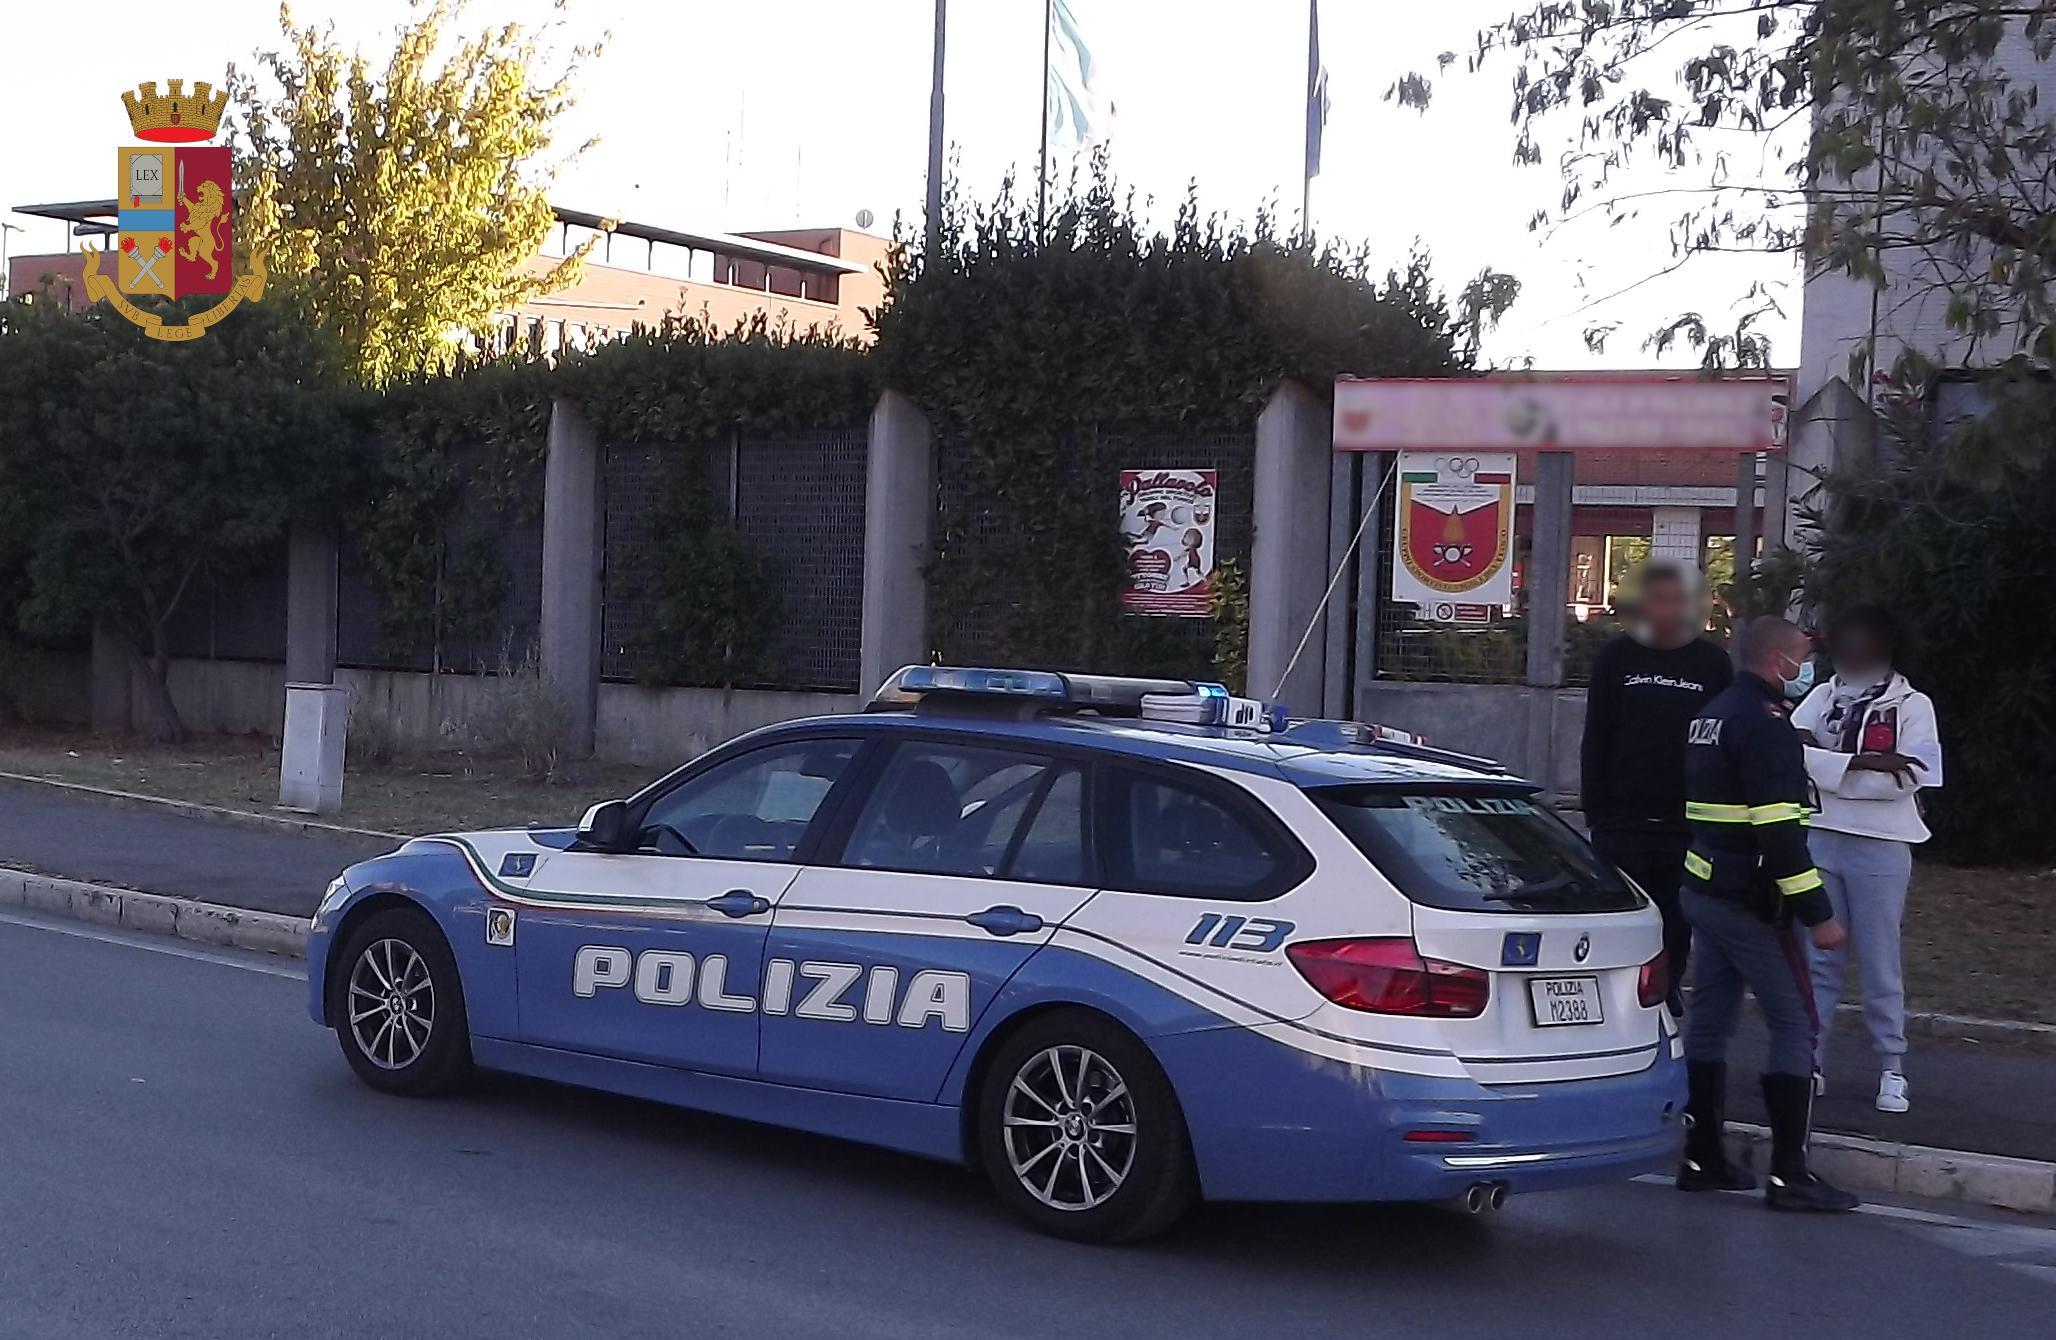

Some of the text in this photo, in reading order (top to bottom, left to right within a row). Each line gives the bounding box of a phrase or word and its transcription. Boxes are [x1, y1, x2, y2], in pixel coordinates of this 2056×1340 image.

[1653, 675, 1676, 687] Klein
[1402, 795, 1541, 816] POLIZIA
[1185, 912, 1297, 954] 113
[571, 943, 972, 1034] POLIZIA
[1546, 981, 1584, 996] POLIZIA
